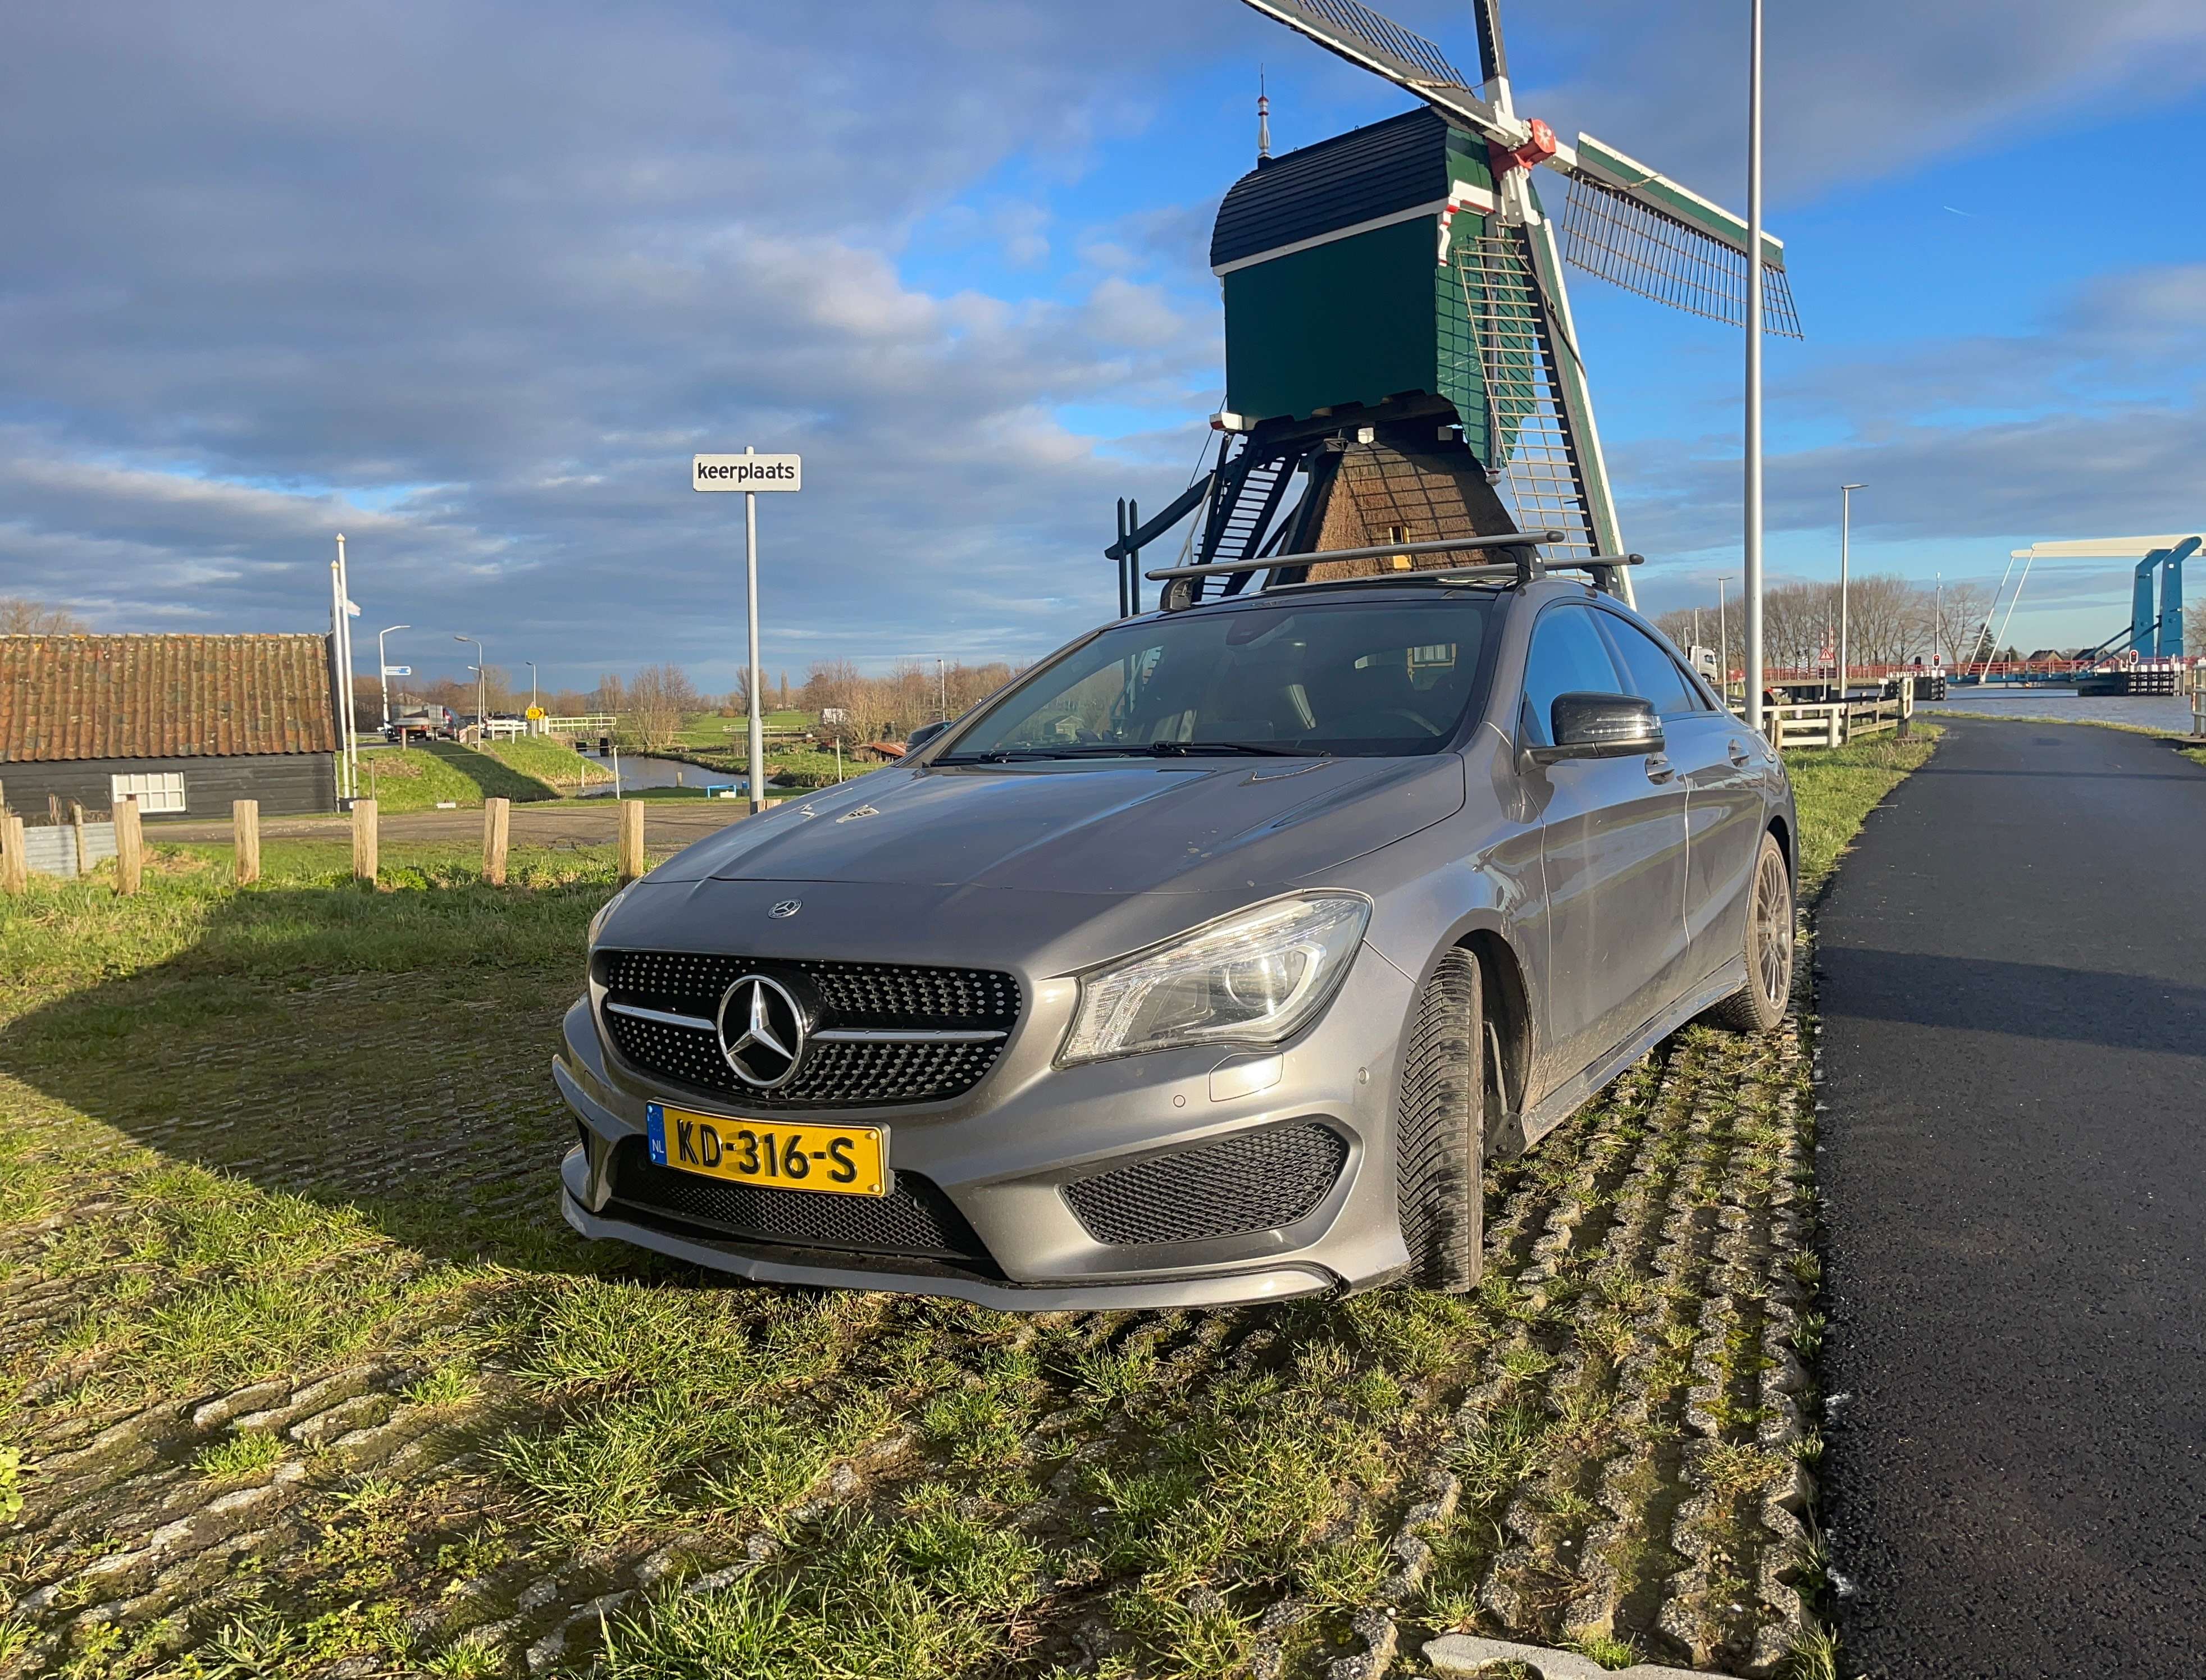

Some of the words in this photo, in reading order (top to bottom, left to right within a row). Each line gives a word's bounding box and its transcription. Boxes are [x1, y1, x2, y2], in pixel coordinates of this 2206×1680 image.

[698, 462, 795, 483] keerplaats
[652, 1139, 664, 1153] NL
[676, 1119, 858, 1183] KD-316-S
